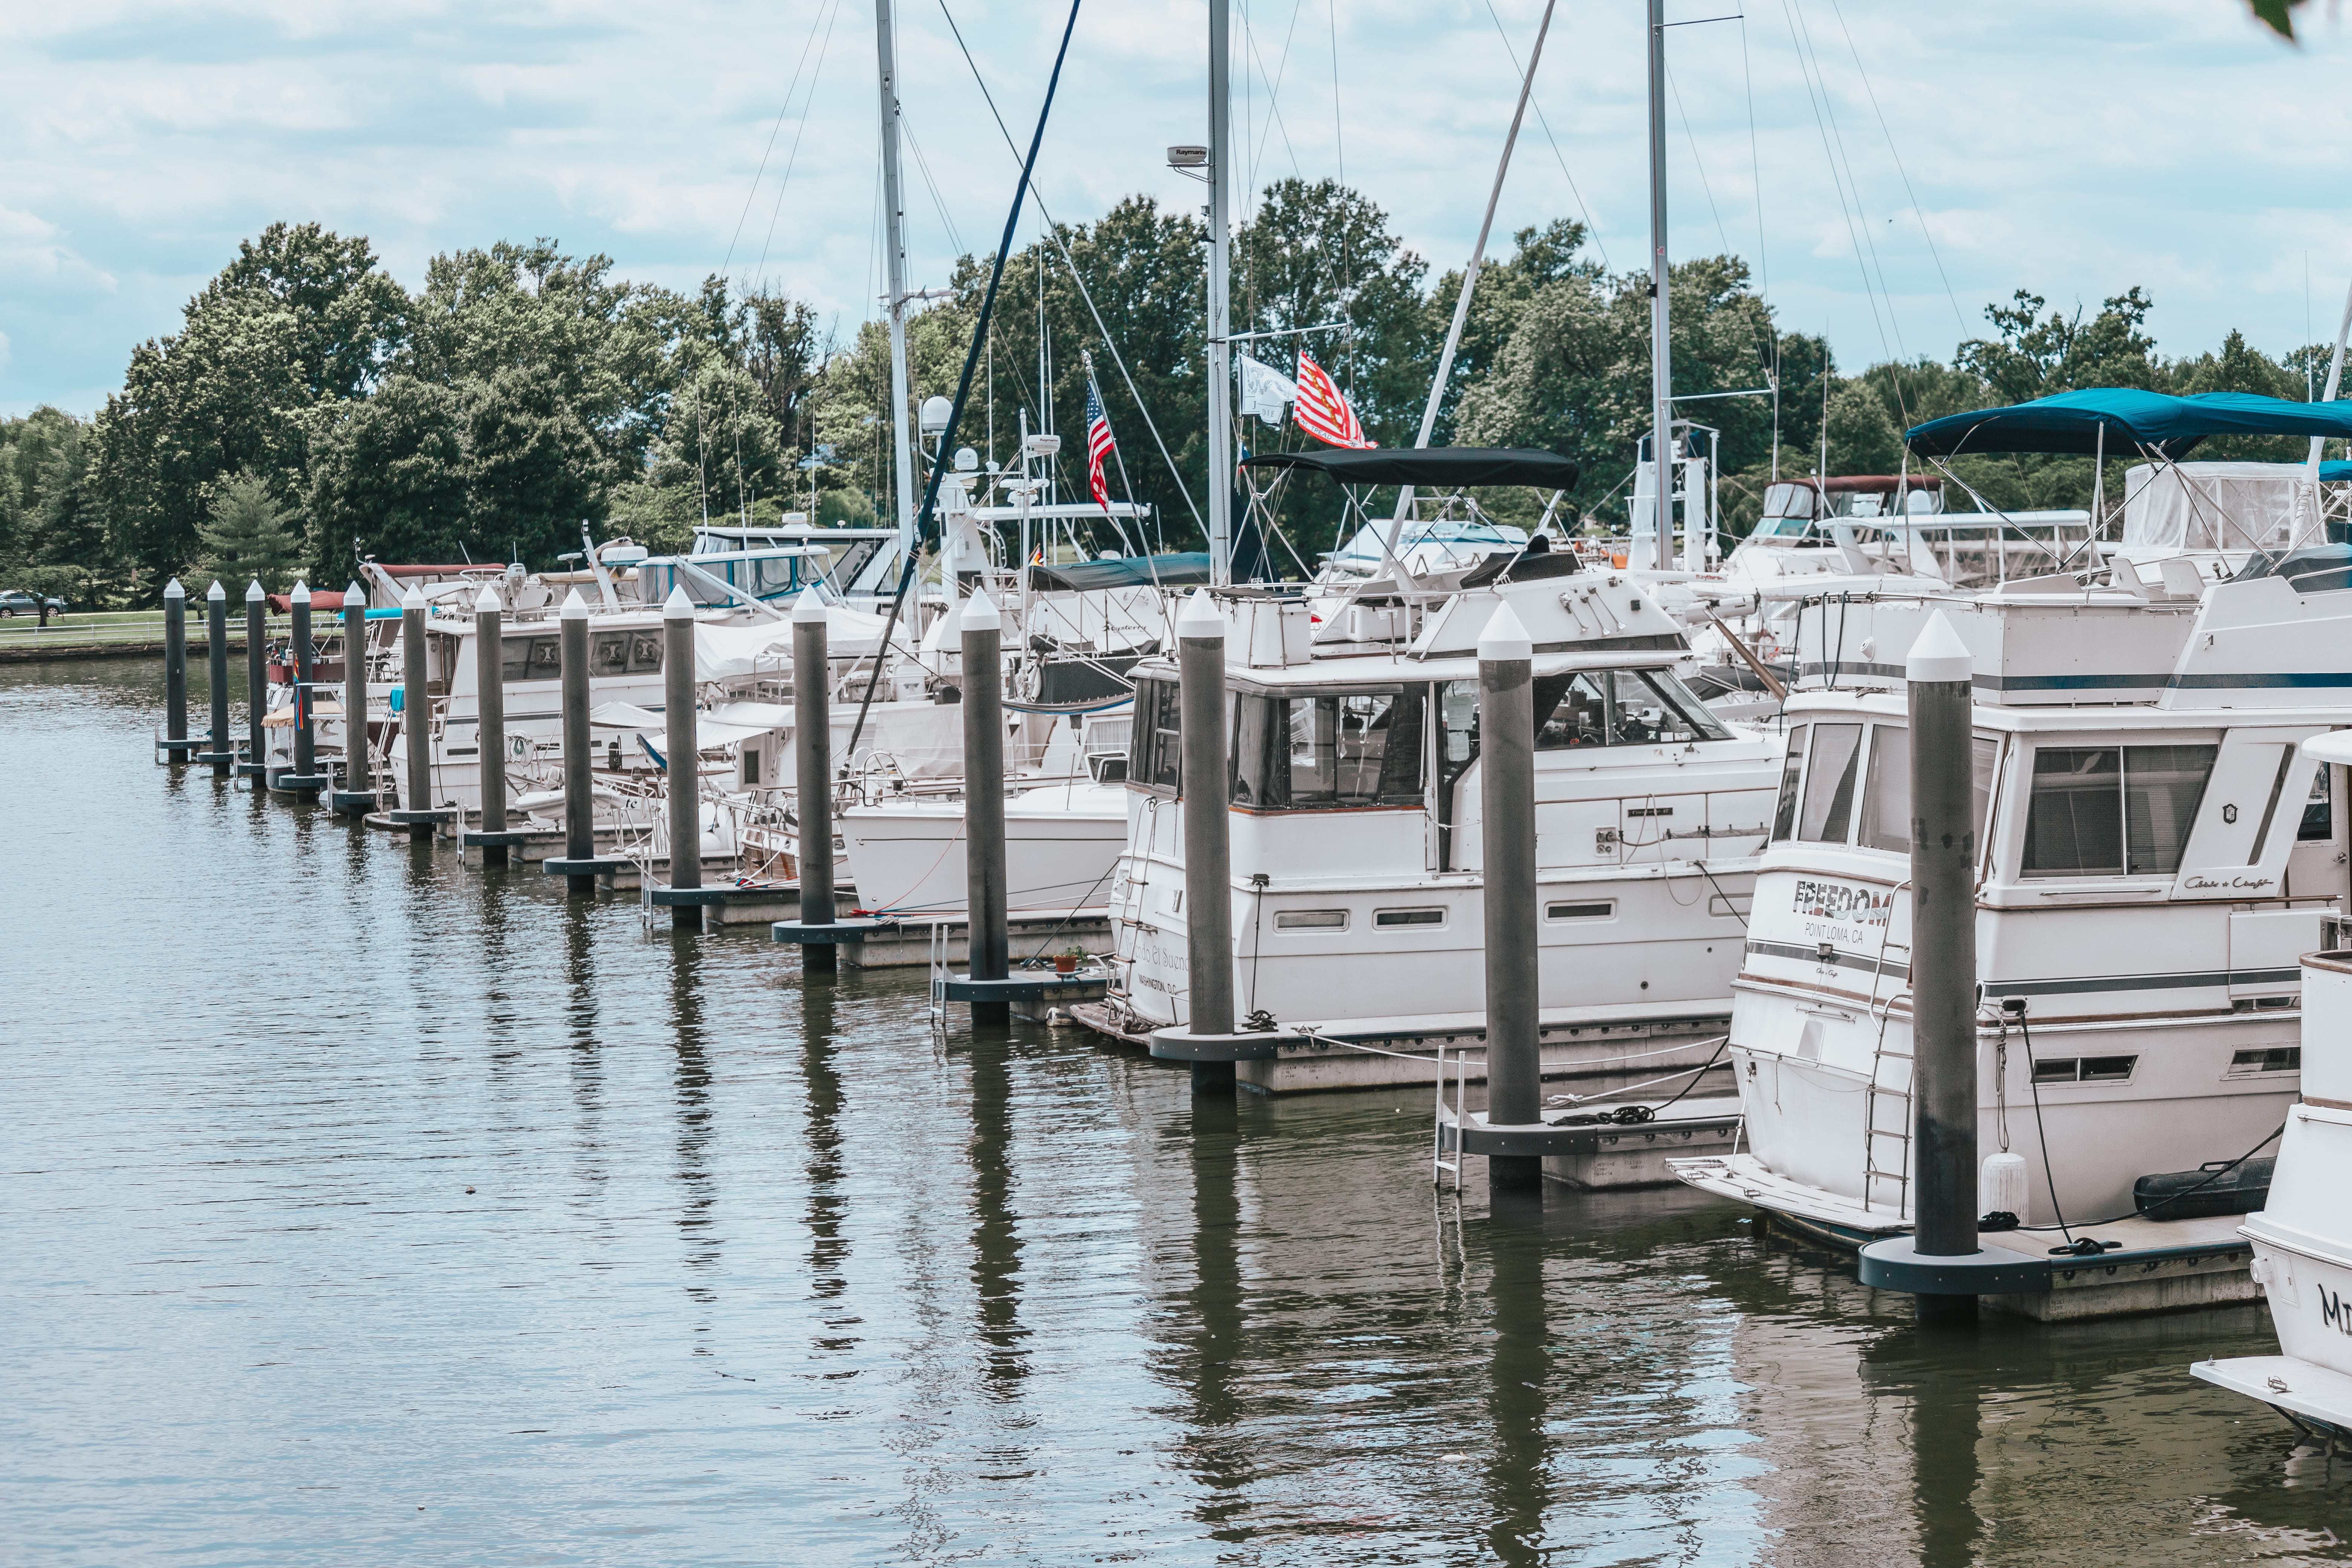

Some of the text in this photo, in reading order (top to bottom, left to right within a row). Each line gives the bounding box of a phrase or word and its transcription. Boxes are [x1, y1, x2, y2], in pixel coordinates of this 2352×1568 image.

[1262, 409, 1274, 417] DIE
[1311, 426, 1332, 439] TREAD
[2184, 876, 2274, 890] Chris Craft
[1793, 880, 1891, 927] FREEDOM
[1805, 922, 1863, 945] POINT LOMA, CA
[1152, 945, 1161, 965] El
[1138, 973, 1167, 994] WASHINGTON,
